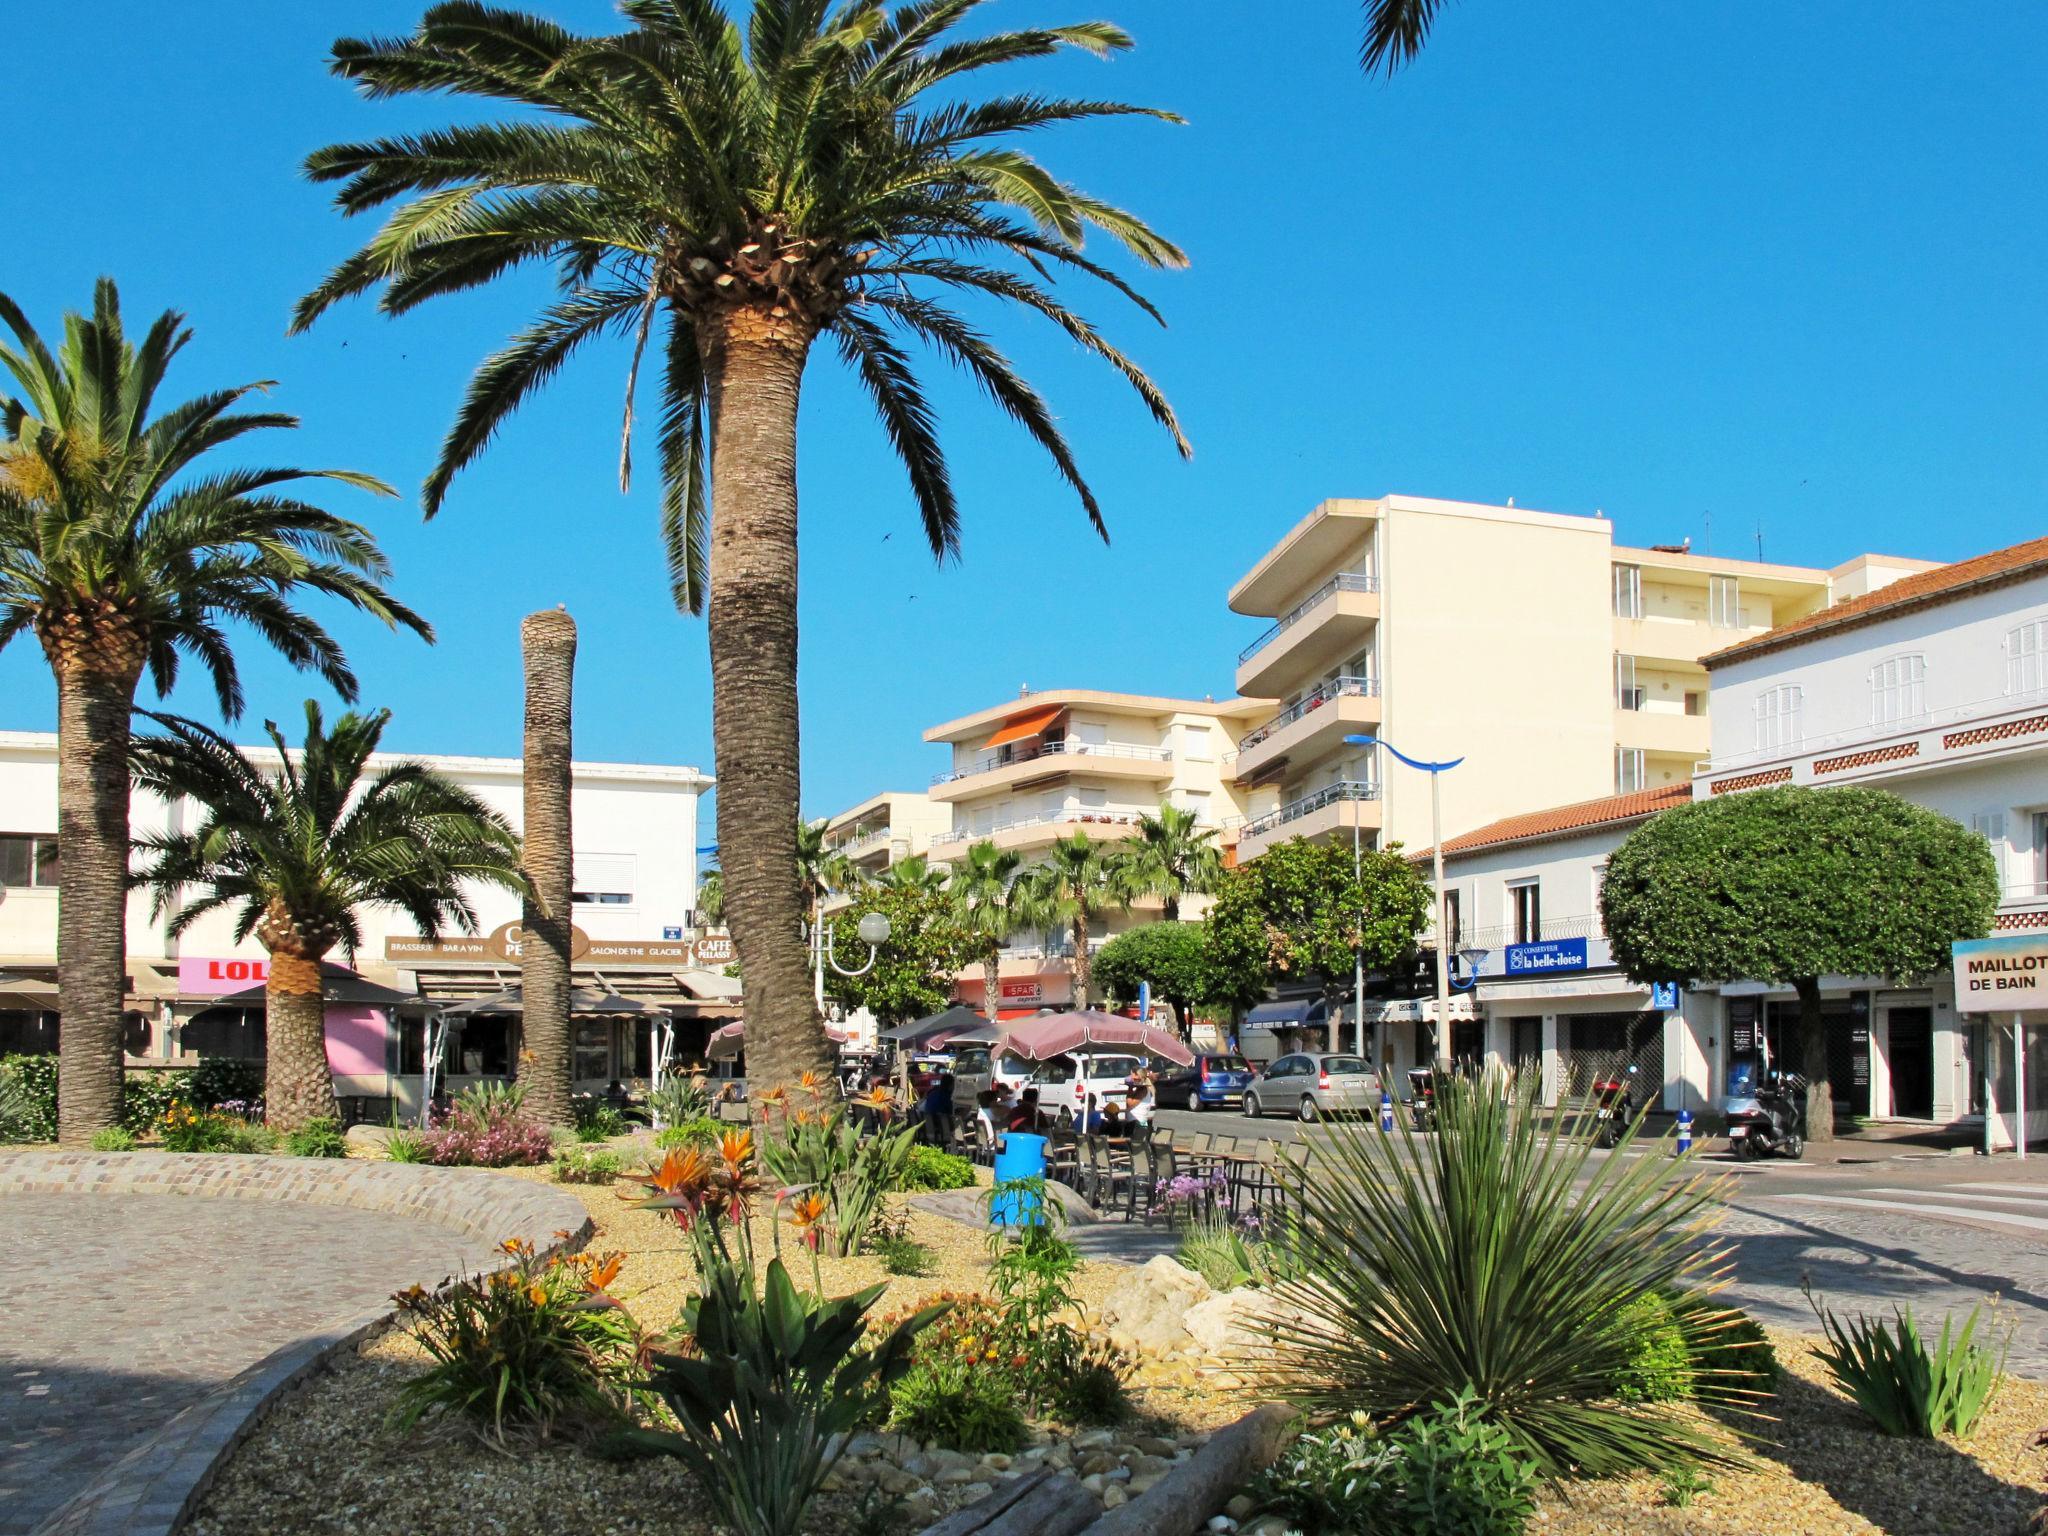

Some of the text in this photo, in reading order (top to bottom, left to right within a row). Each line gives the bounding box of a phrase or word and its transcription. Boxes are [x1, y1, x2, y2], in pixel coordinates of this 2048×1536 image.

[391, 943, 434, 952] BRASSERIE
[442, 944, 458, 952] BAR
[468, 945, 483, 953] VIN
[698, 940, 732, 951] CAFFE
[1523, 944, 1558, 954] CONSERVERIE
[590, 947, 644, 955] SALON DE THE
[648, 948, 682, 956] GLACIER
[1524, 952, 1582, 969] la belle-iloise
[1970, 976, 2036, 991] DE BAIN
[1011, 986, 1034, 995] SPAR
